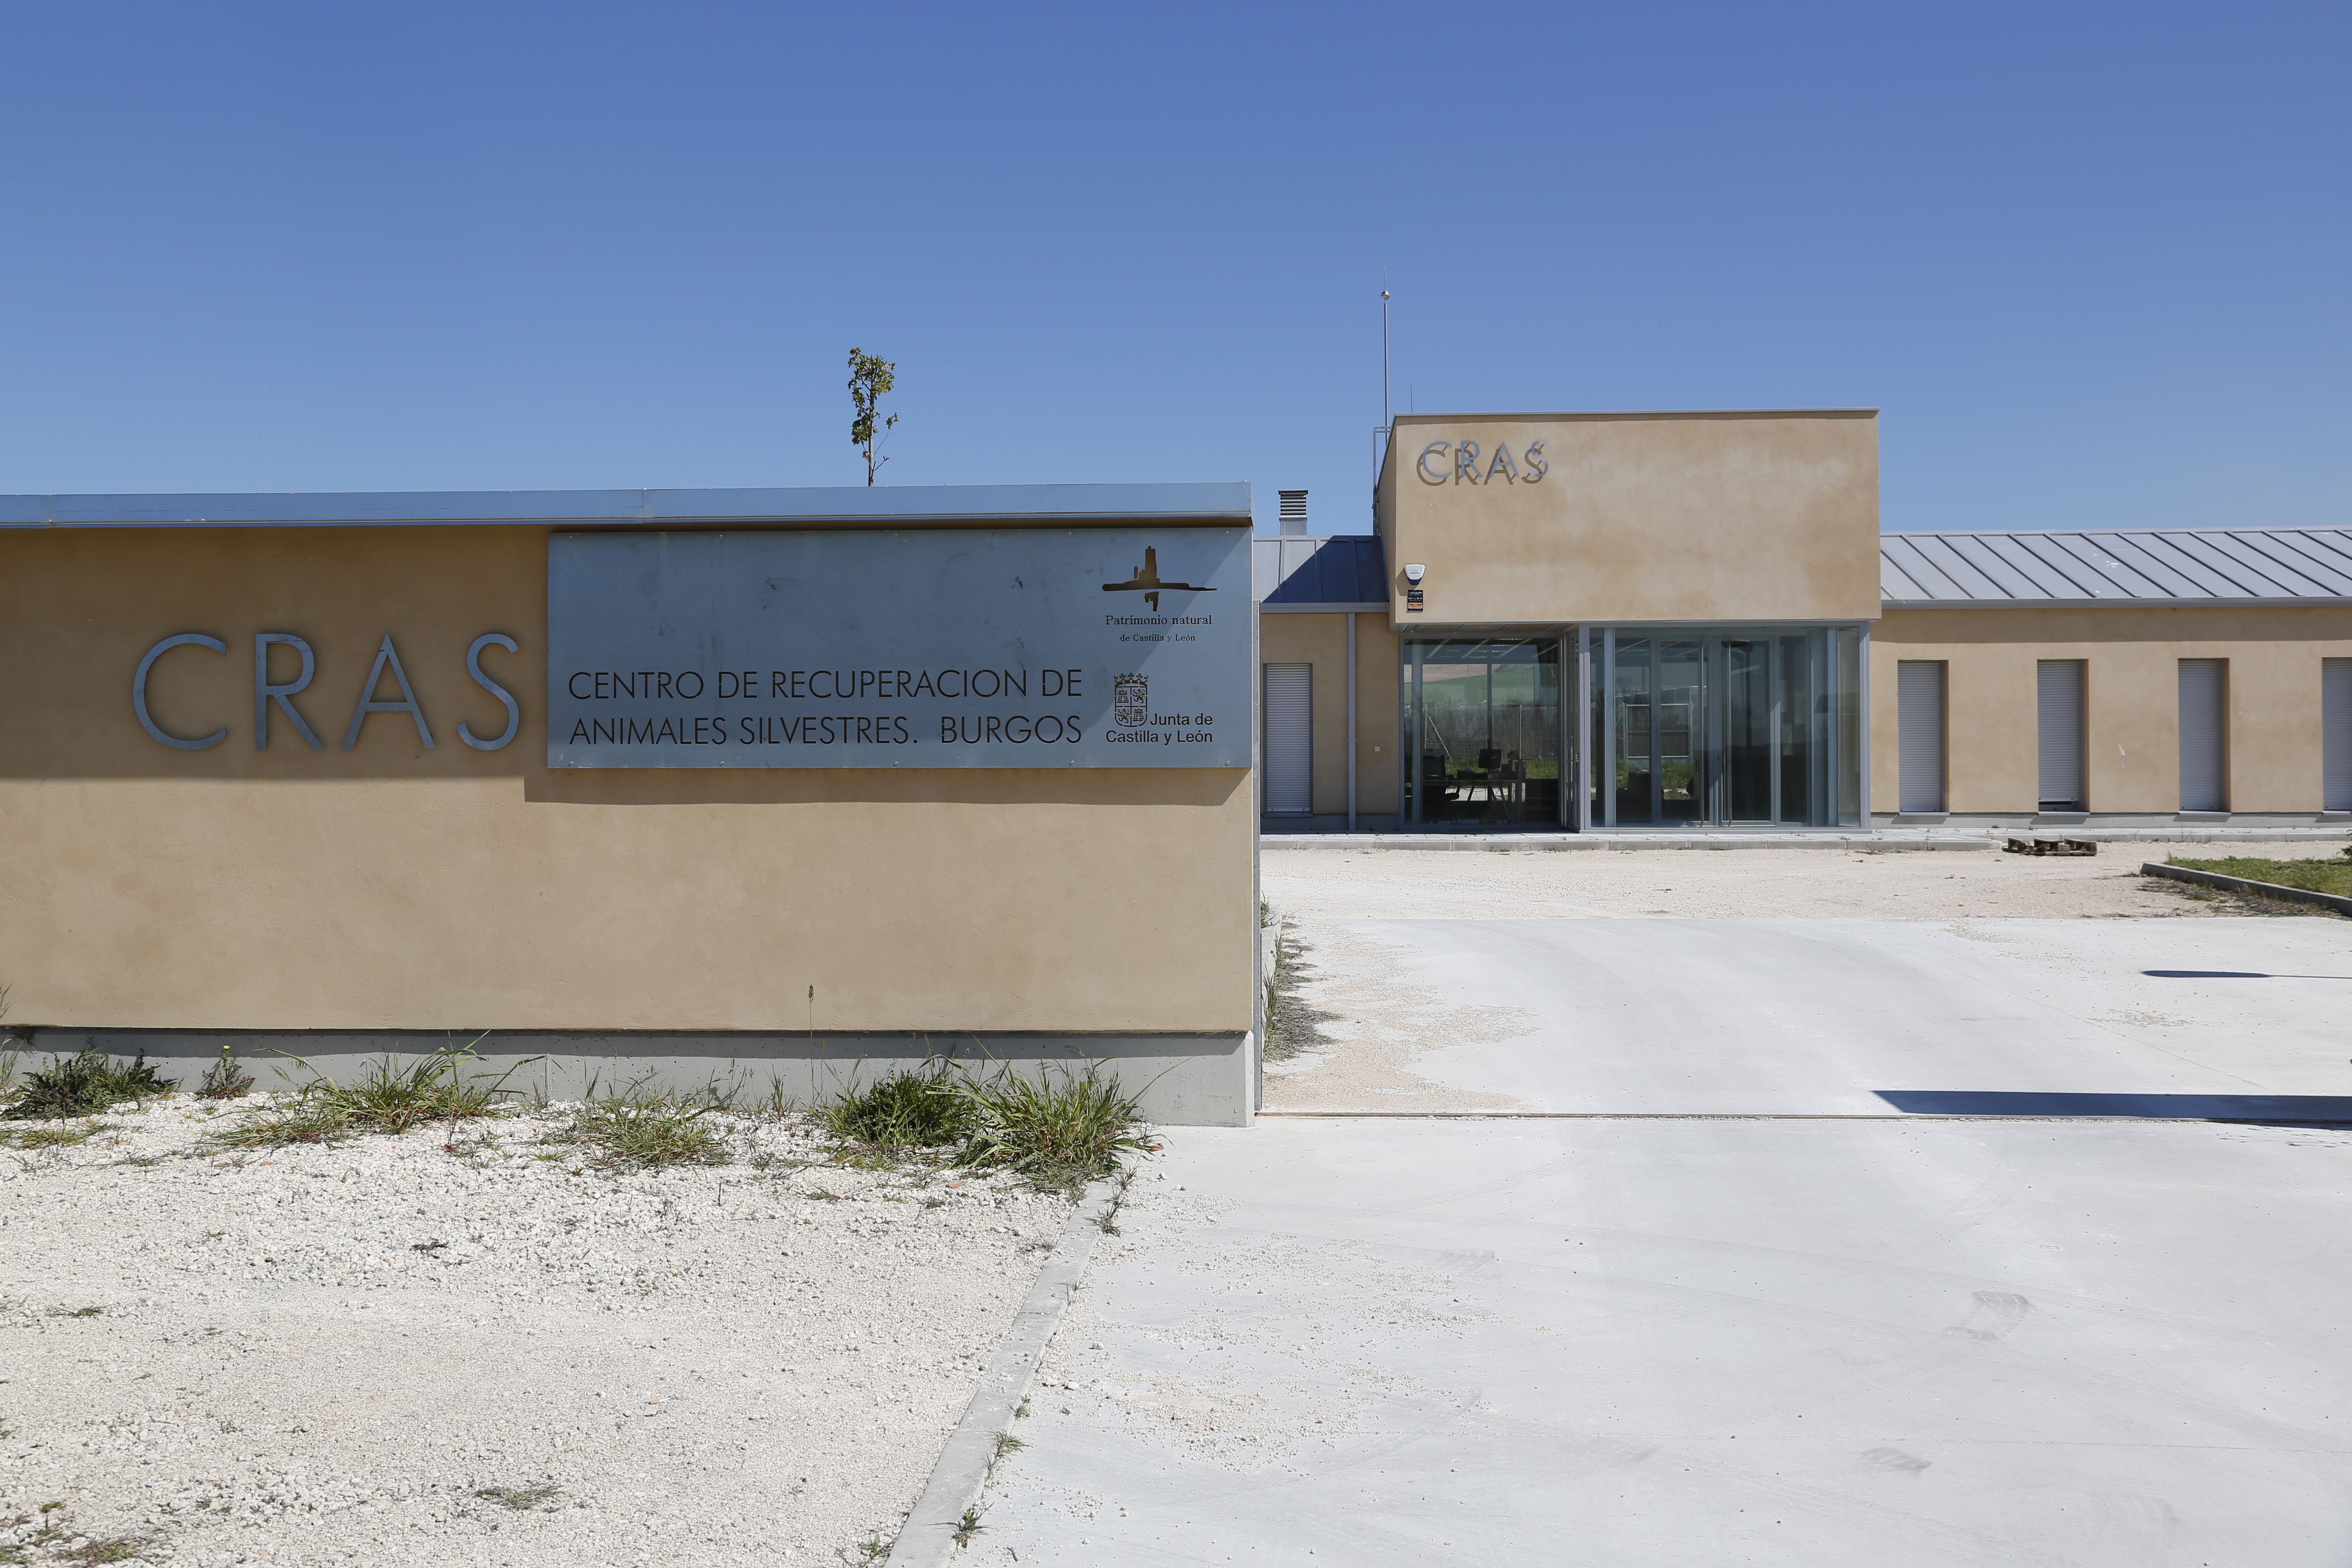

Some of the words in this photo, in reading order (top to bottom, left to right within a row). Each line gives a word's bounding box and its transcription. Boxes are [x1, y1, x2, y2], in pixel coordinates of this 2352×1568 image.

[1422, 440, 1549, 478] CRAS
[1105, 615, 1168, 625] Patrimonio
[1172, 615, 1212, 625] natural
[133, 633, 519, 751] CRAS
[568, 671, 704, 700] CENTRO
[718, 671, 757, 699] DE
[772, 669, 1027, 699] RECUPERACION
[1042, 669, 1082, 697] DE
[569, 717, 727, 745] ANIMALES
[739, 716, 918, 745] SILVESTRES.
[941, 715, 1082, 744] BURGOS
[1150, 713, 1190, 726] Junta
[1195, 713, 1213, 726] de
[1106, 730, 1159, 743] Castilla
[1163, 733, 1173, 746] y
[1177, 730, 1213, 742] León
